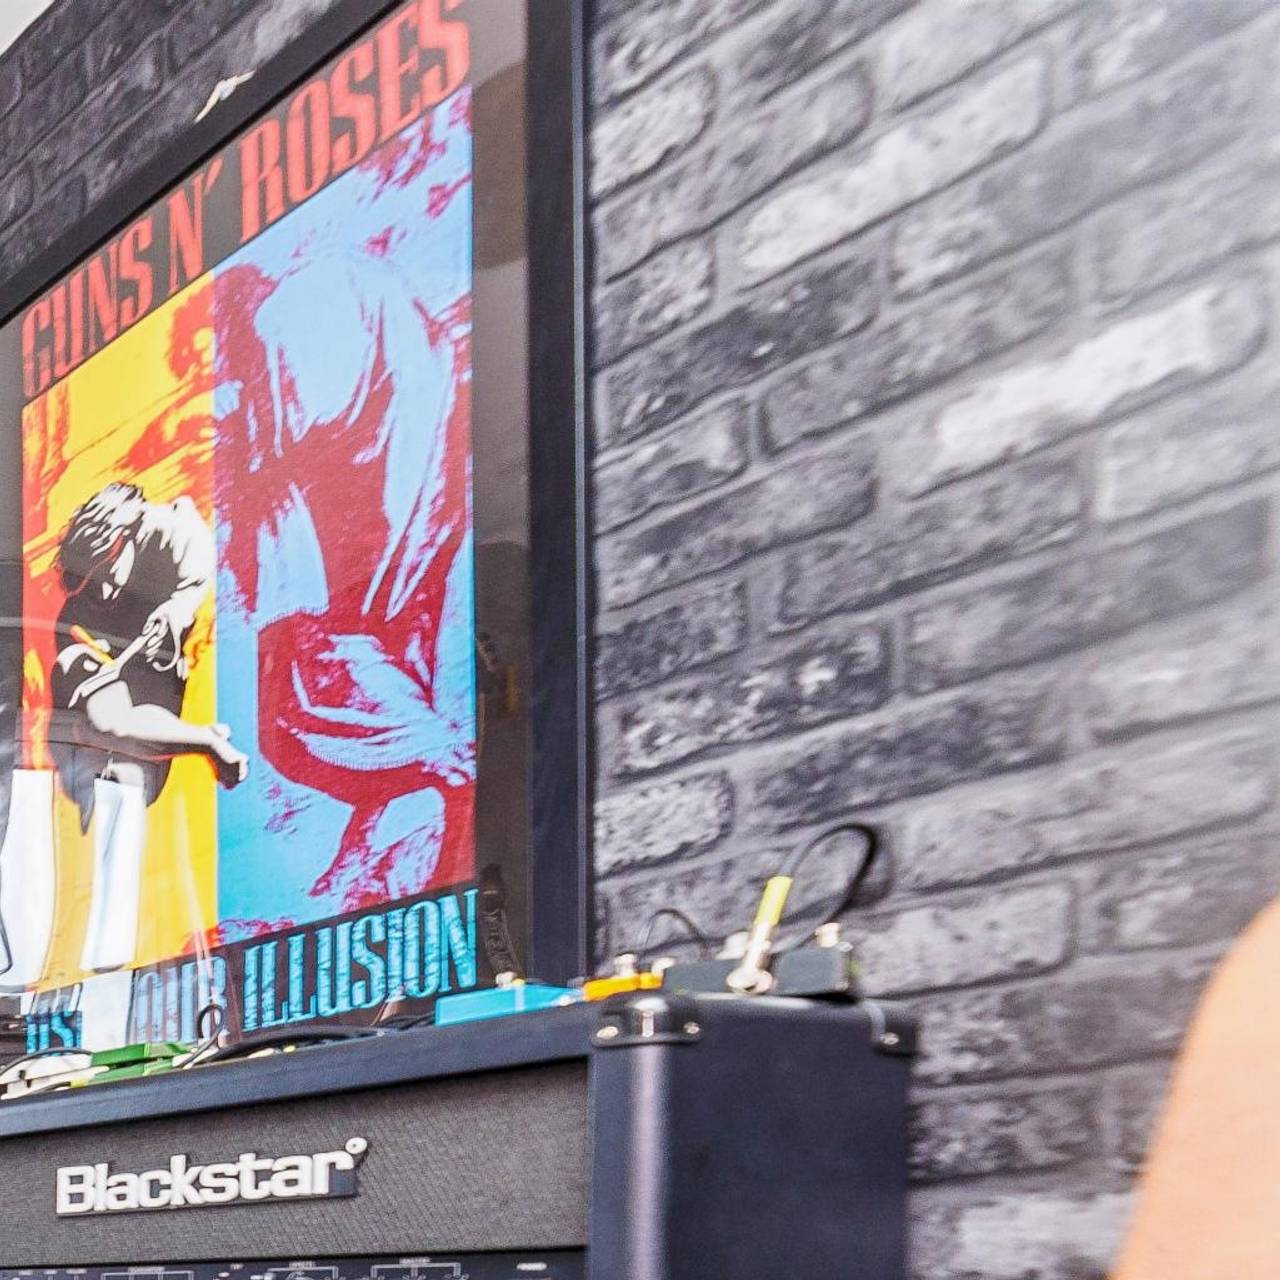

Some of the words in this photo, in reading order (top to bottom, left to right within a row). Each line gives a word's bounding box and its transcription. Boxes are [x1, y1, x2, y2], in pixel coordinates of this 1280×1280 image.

[22, 218, 154, 397] GUNS
[167, 158, 221, 294] N'
[239, 0, 472, 245] ROSES
[241, 889, 479, 1033] ILLUSION
[56, 1147, 356, 1214] Blackstar
